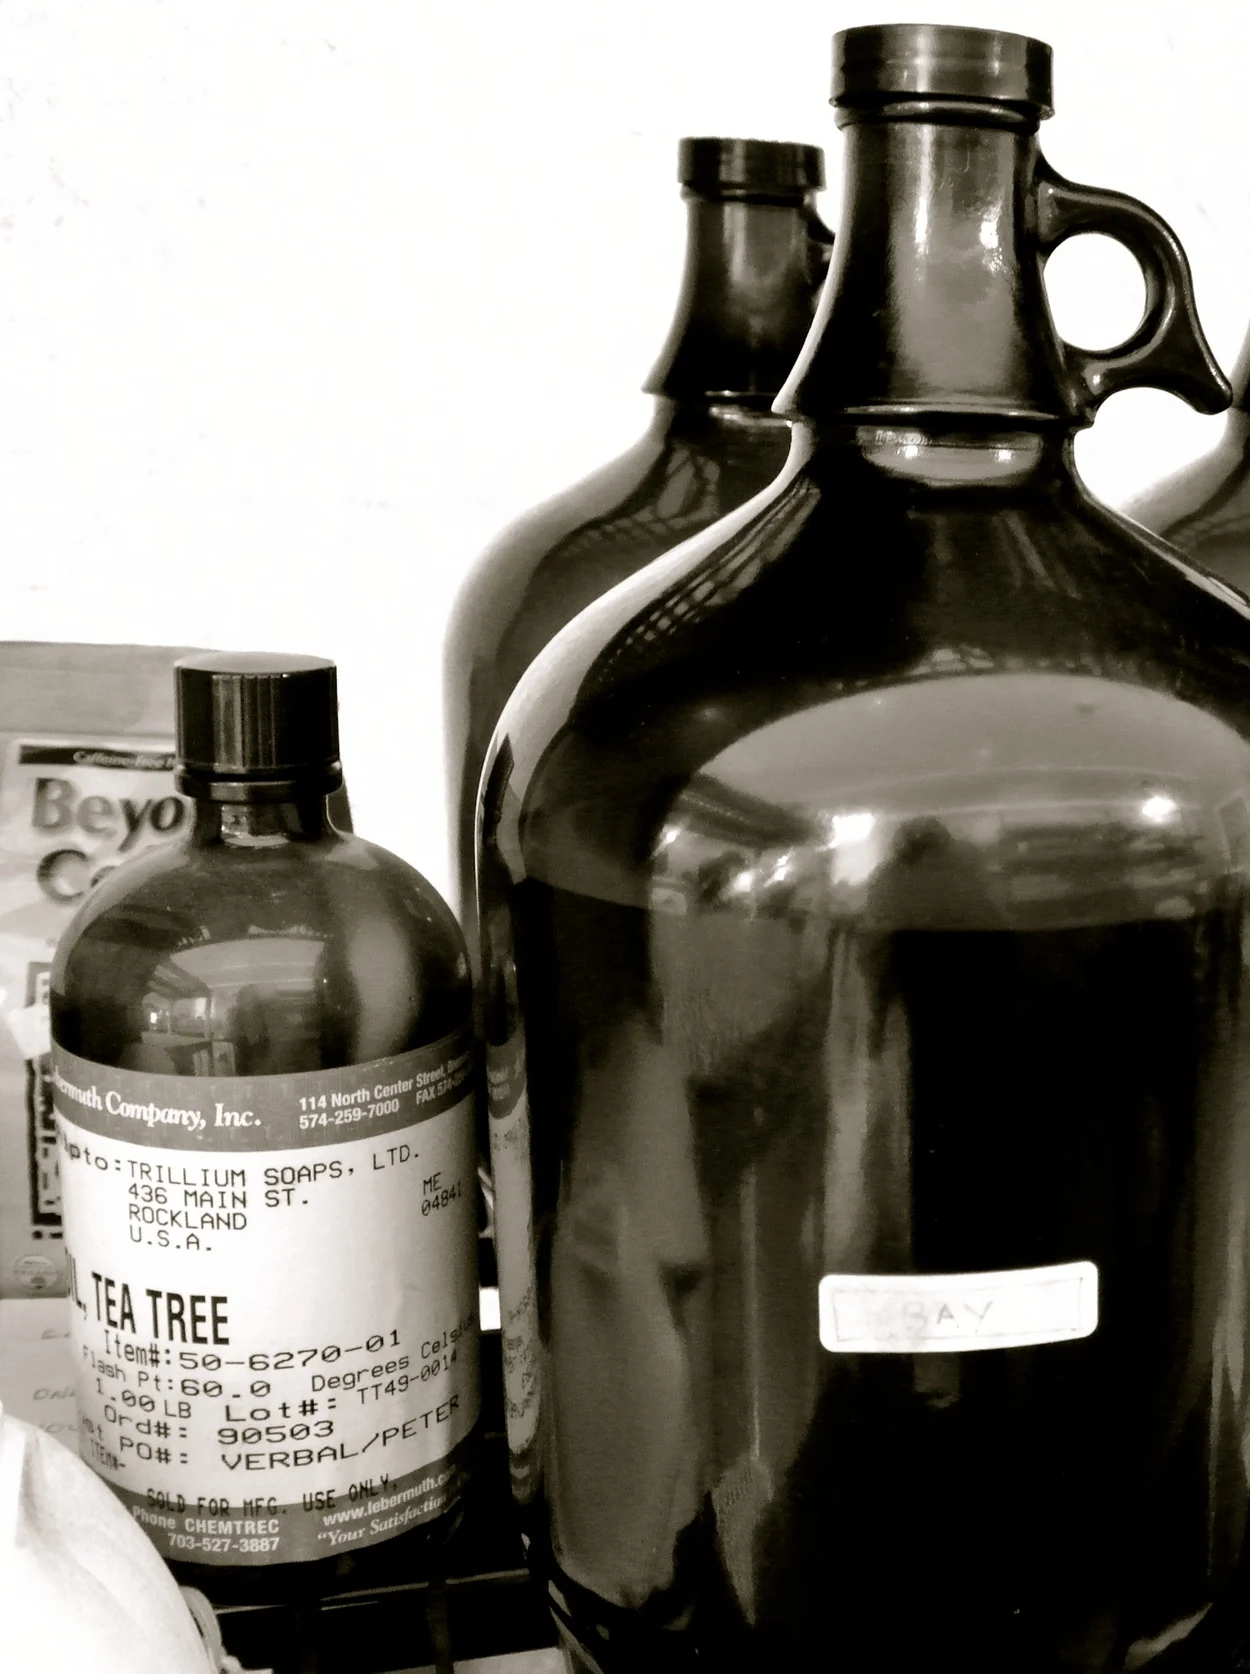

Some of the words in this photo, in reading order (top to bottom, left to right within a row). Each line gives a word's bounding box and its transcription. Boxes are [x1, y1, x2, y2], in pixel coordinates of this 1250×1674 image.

[105, 1091, 207, 1132] Company,
[213, 1102, 262, 1127] Inc.
[299, 1095, 328, 1112] 114
[331, 1087, 370, 1108] North
[374, 1078, 413, 1098] Center
[299, 1098, 400, 1130] 574-259-7000
[415, 1085, 435, 1105] FAX
[263, 1160, 355, 1187] SOAPS,
[372, 1144, 420, 1171] LTD.
[422, 1171, 442, 1196] ME
[128, 1183, 168, 1205] 436
[184, 1189, 247, 1209] MAIN
[264, 1188, 309, 1208] ST.
[420, 1181, 462, 1217] 04841
[128, 1203, 247, 1231] ROCKLAND
[129, 1225, 213, 1251] U.S.A.
[91, 1270, 137, 1334] TEA
[145, 1288, 230, 1345] TREE
[900, 1299, 994, 1334] BAY
[311, 1355, 410, 1392] Degrees
[96, 1377, 155, 1413] 1.00
[164, 1399, 192, 1419] LB
[225, 1397, 337, 1423] Lot#:
[104, 1404, 188, 1439] Ord#:
[217, 1419, 334, 1445] 90503
[118, 1436, 188, 1465] PO#:
[221, 1394, 460, 1471] VERBAL/PETER
[131, 1505, 176, 1530] Phone
[184, 1517, 281, 1536] CHEMTREC
[146, 1488, 186, 1514] SOLD
[197, 1497, 230, 1517] FOR
[243, 1496, 288, 1517] MFG.
[302, 1488, 336, 1513] USE
[167, 1532, 281, 1553] 703-527-3887
